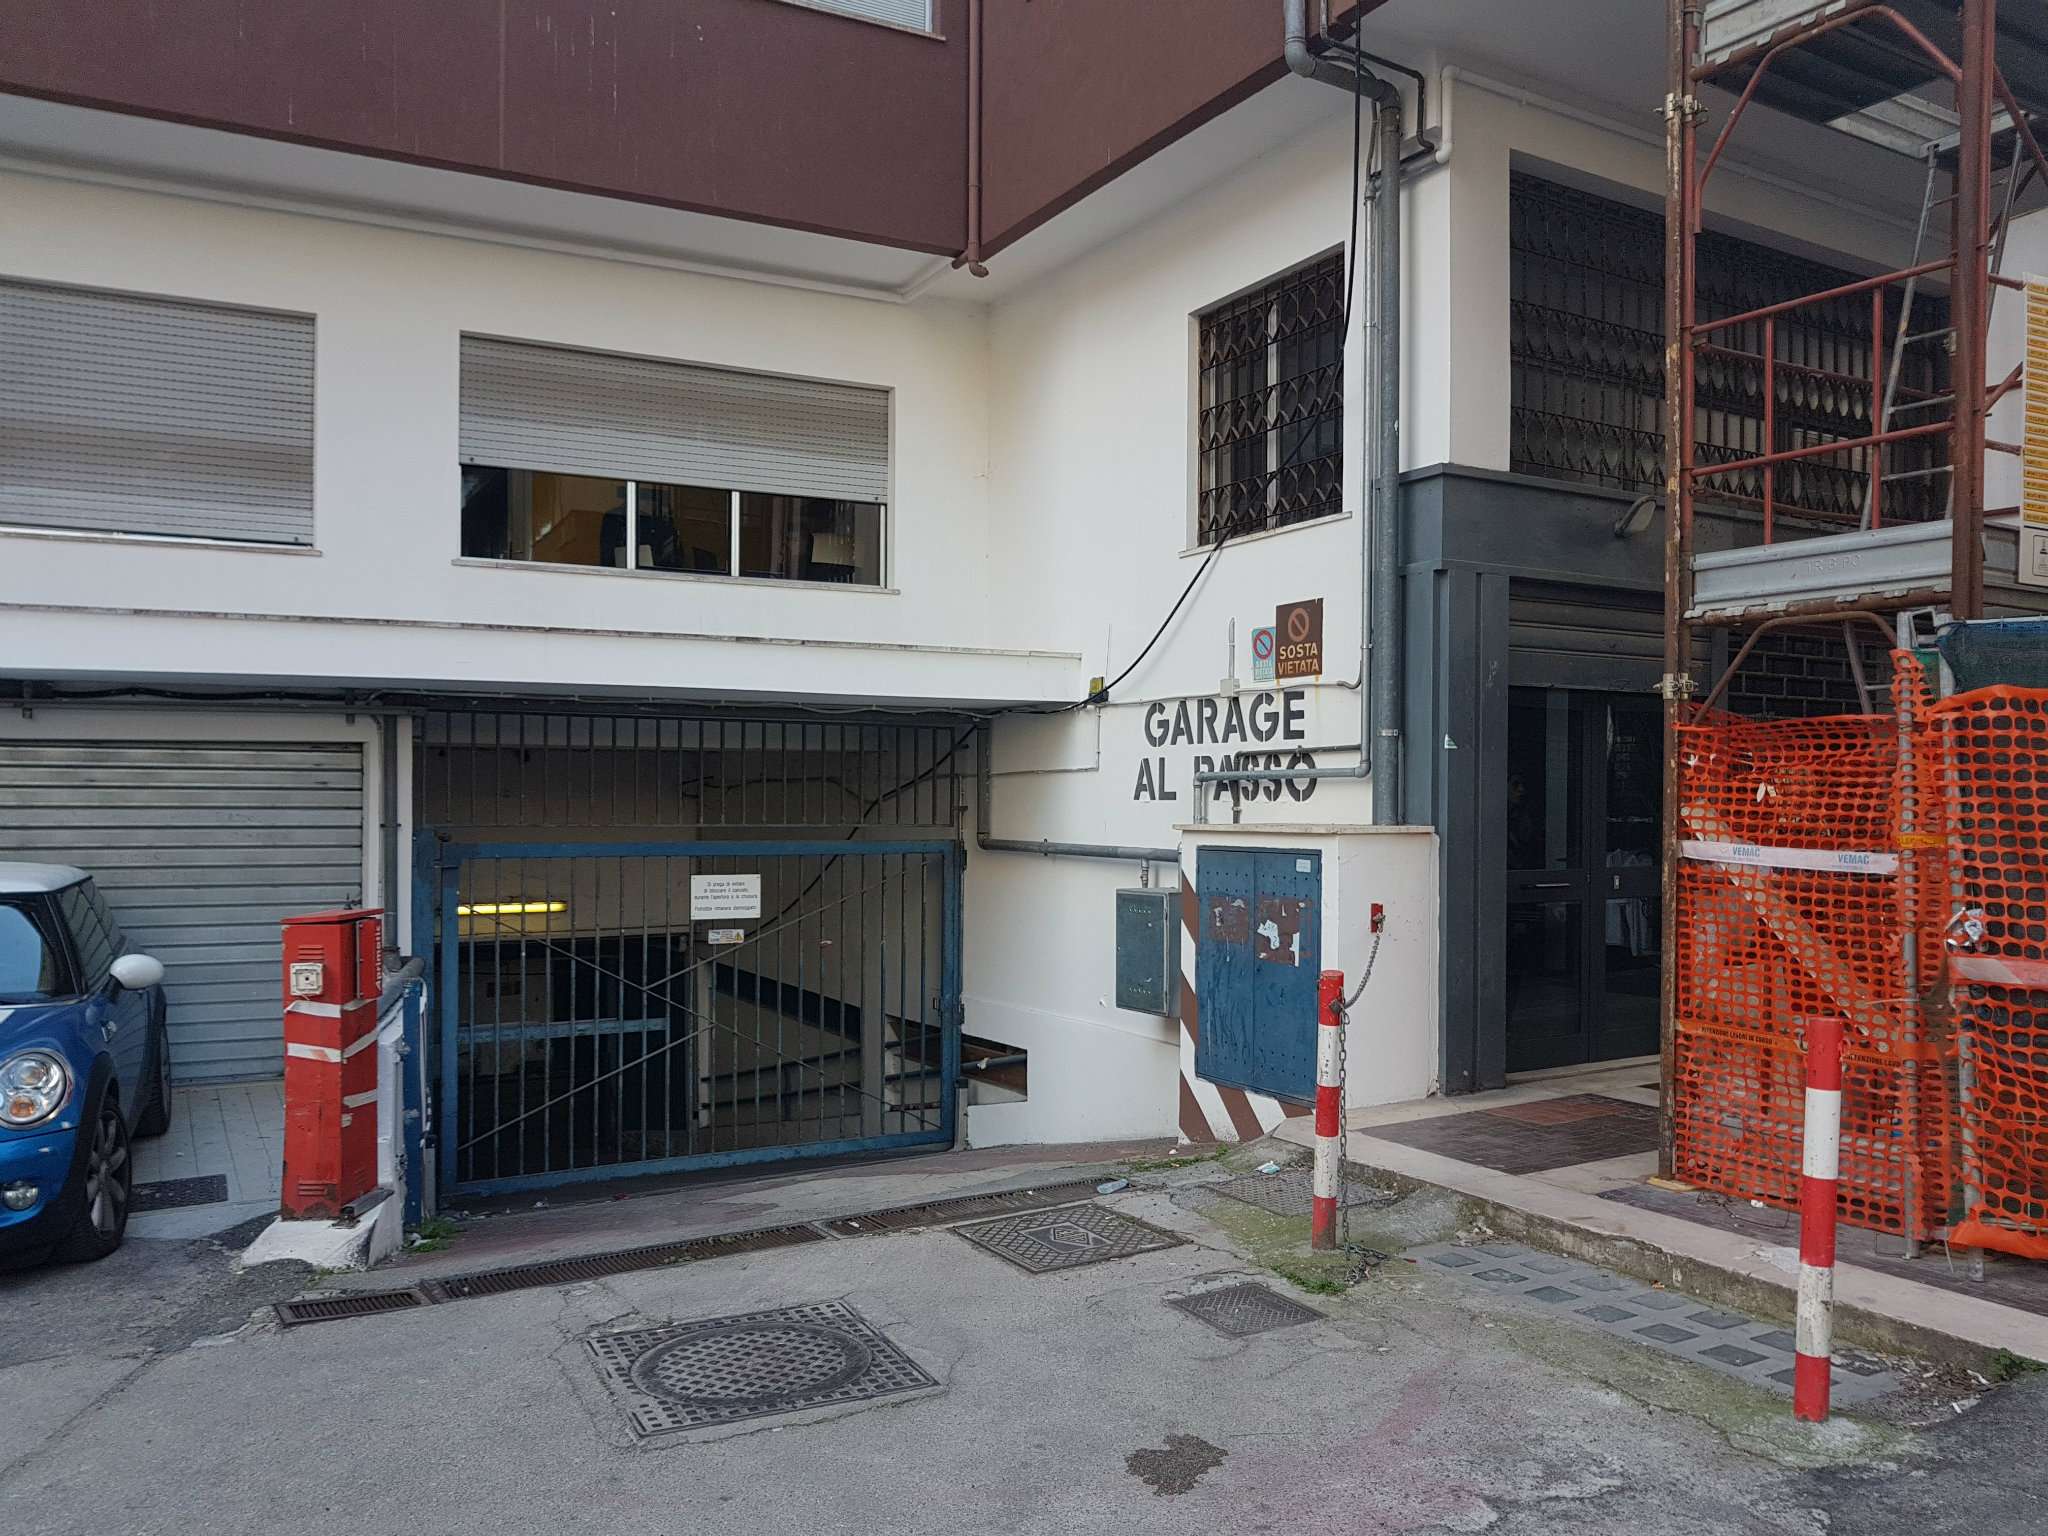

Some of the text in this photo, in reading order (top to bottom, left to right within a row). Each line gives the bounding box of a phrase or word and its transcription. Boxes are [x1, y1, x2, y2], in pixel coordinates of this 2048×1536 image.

[1279, 642, 1318, 660] SOSTA
[1277, 659, 1320, 675] VIETATA
[1144, 691, 1305, 748] GARAGE
[1133, 752, 1318, 802] AL PASSO
[1732, 846, 1870, 865] VEMAC VEMAC
